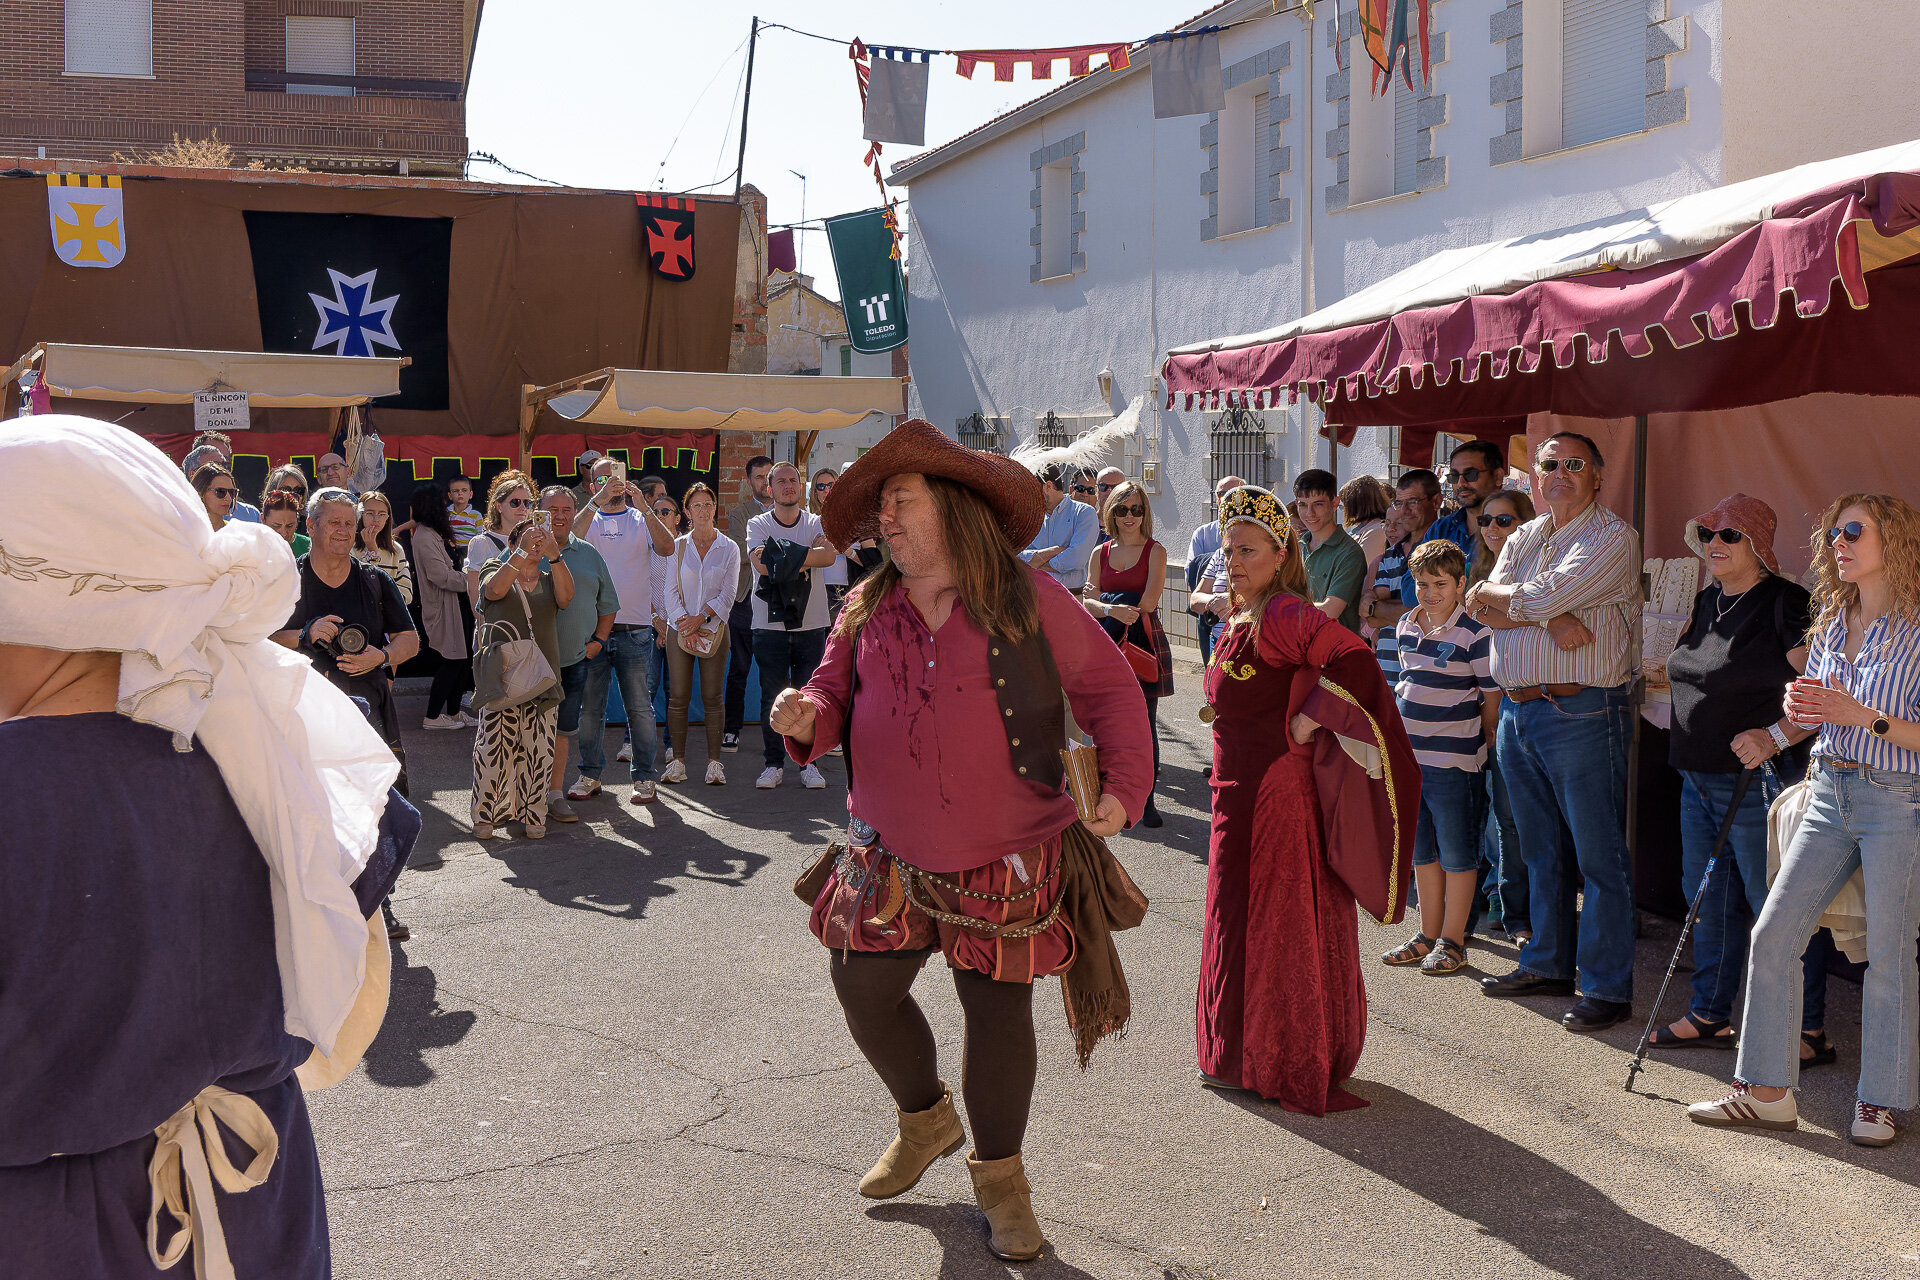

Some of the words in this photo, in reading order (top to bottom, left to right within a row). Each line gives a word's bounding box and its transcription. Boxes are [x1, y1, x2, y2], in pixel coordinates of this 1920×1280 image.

[864, 324, 895, 336] TOLEDO
[195, 395, 210, 403] "EL
[211, 393, 246, 402] RINCÓN
[210, 407, 222, 415] DE
[1433, 642, 1456, 669] 7
